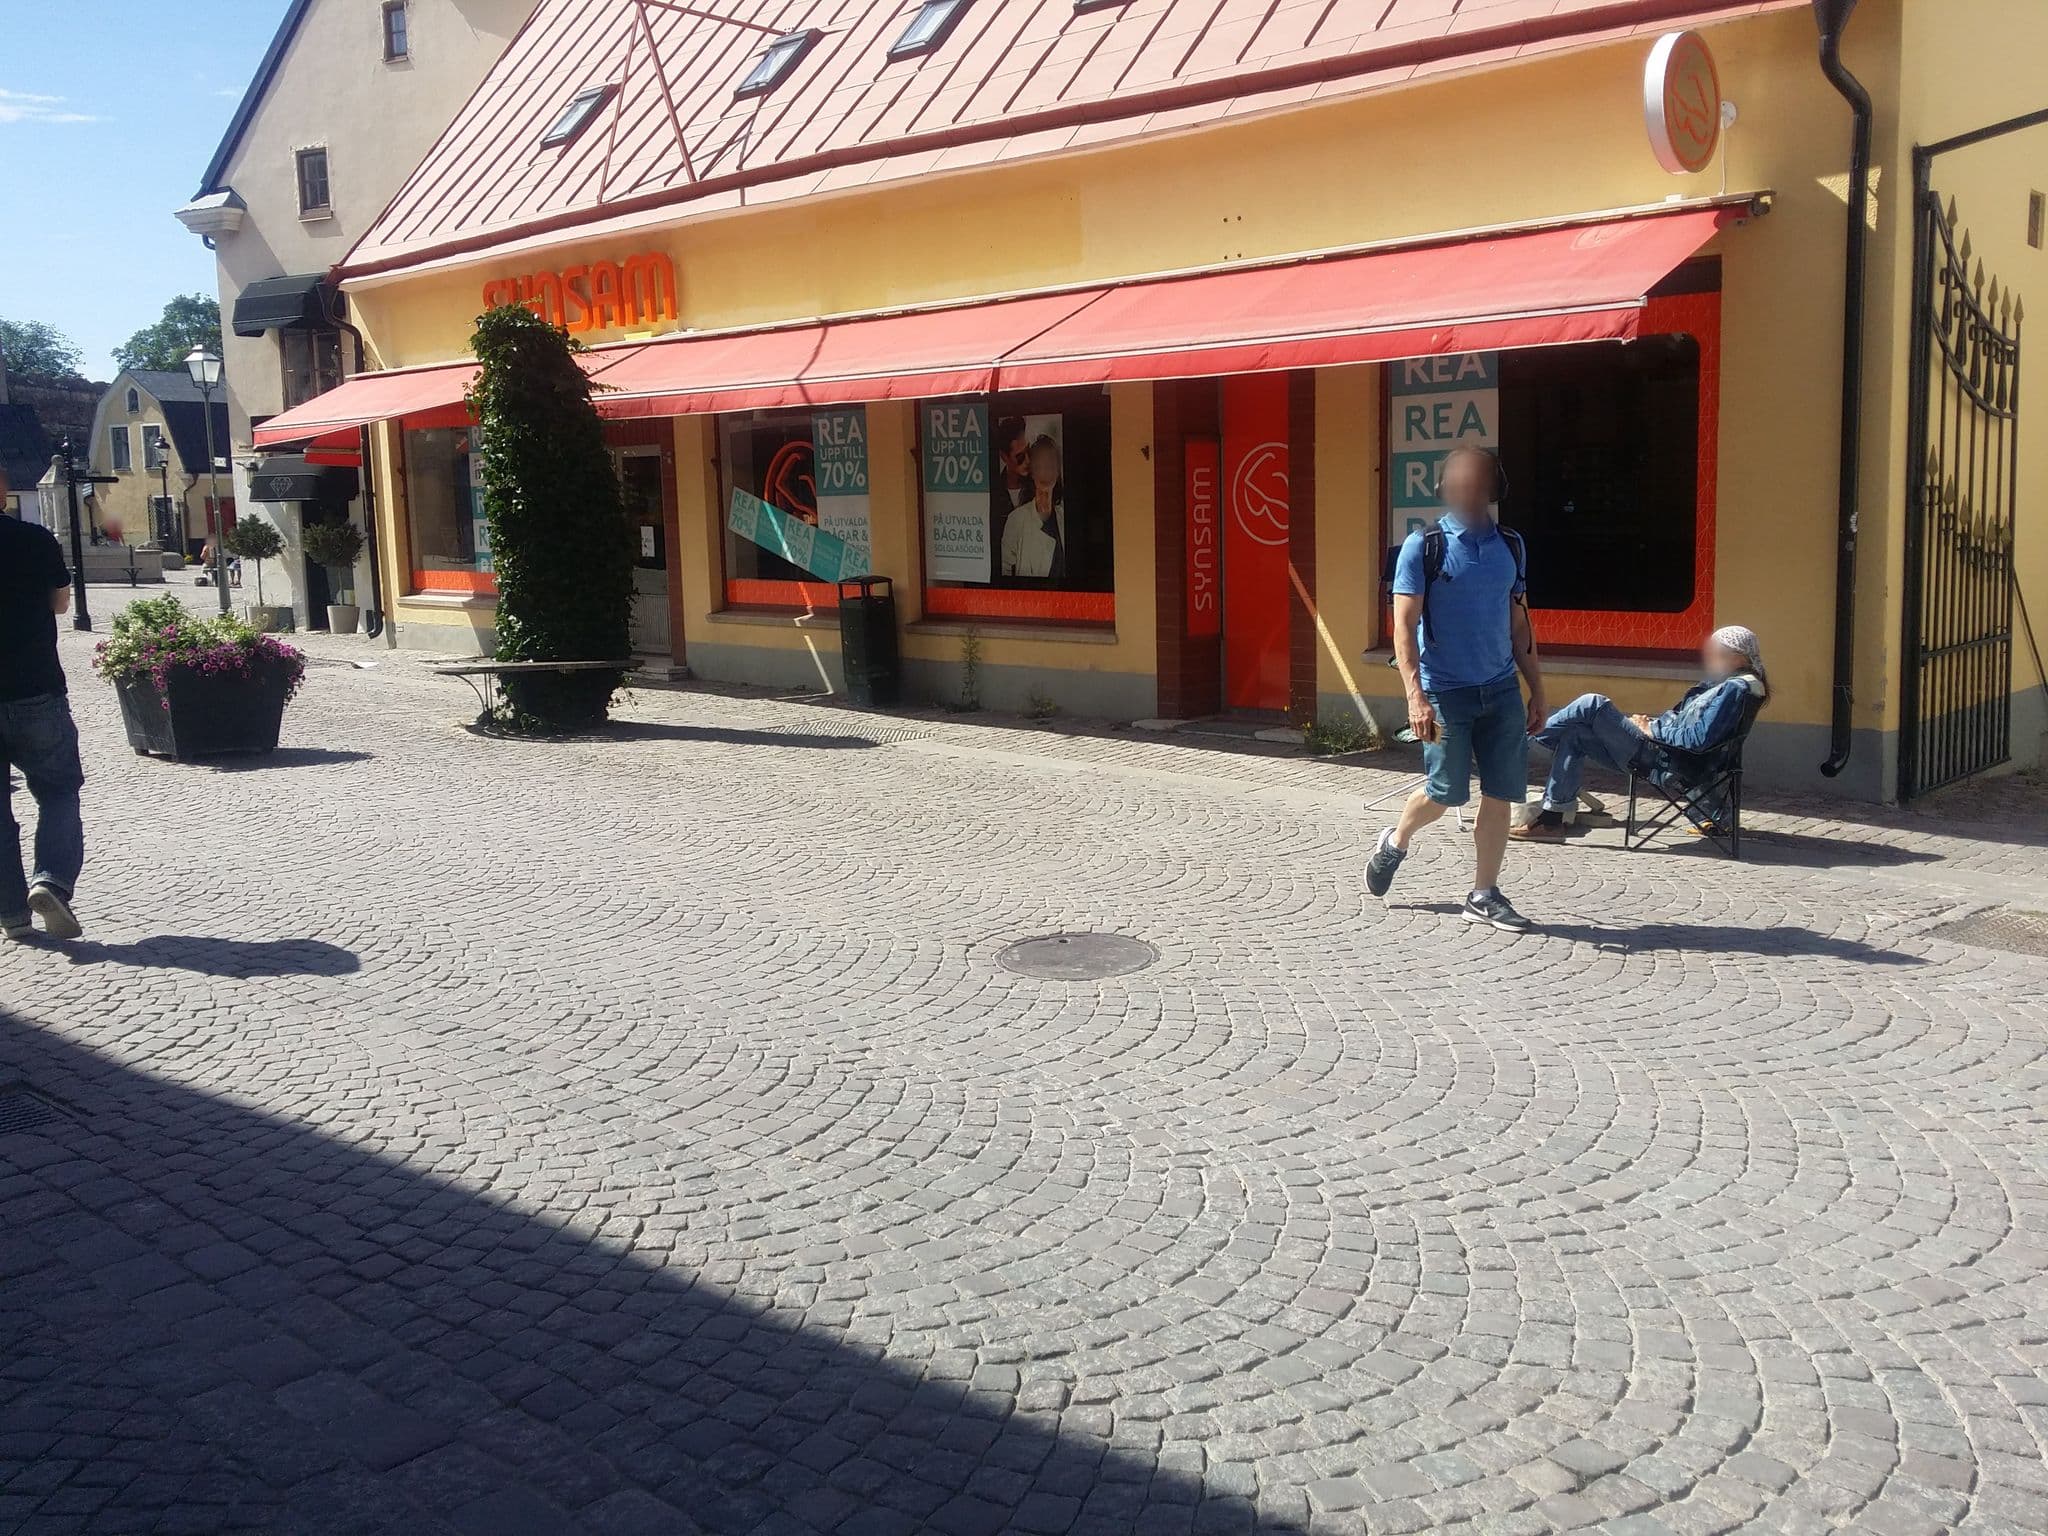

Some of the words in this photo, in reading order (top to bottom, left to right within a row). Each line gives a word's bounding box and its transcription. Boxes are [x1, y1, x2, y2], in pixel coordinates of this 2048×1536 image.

[1404, 353, 1487, 385] REA
[818, 416, 863, 446] REA
[931, 408, 982, 438] REA
[1405, 401, 1487, 440] REA
[821, 447, 840, 460] UPP
[843, 446, 864, 459] TILL
[932, 440, 954, 454] UPP
[958, 440, 982, 454] TILL
[821, 461, 866, 488] 70%
[932, 455, 983, 484] 70%
[735, 490, 756, 513] REA
[788, 518, 810, 542] REA
[834, 516, 868, 527] UTVALDA
[945, 514, 984, 526] UTVALDA
[824, 527, 859, 542] ÅGAR
[862, 529, 869, 542] &
[933, 526, 973, 541] BÅGAR
[975, 529, 984, 542] &
[1193, 467, 1212, 611] SYNSAM
[844, 548, 869, 573] REA
